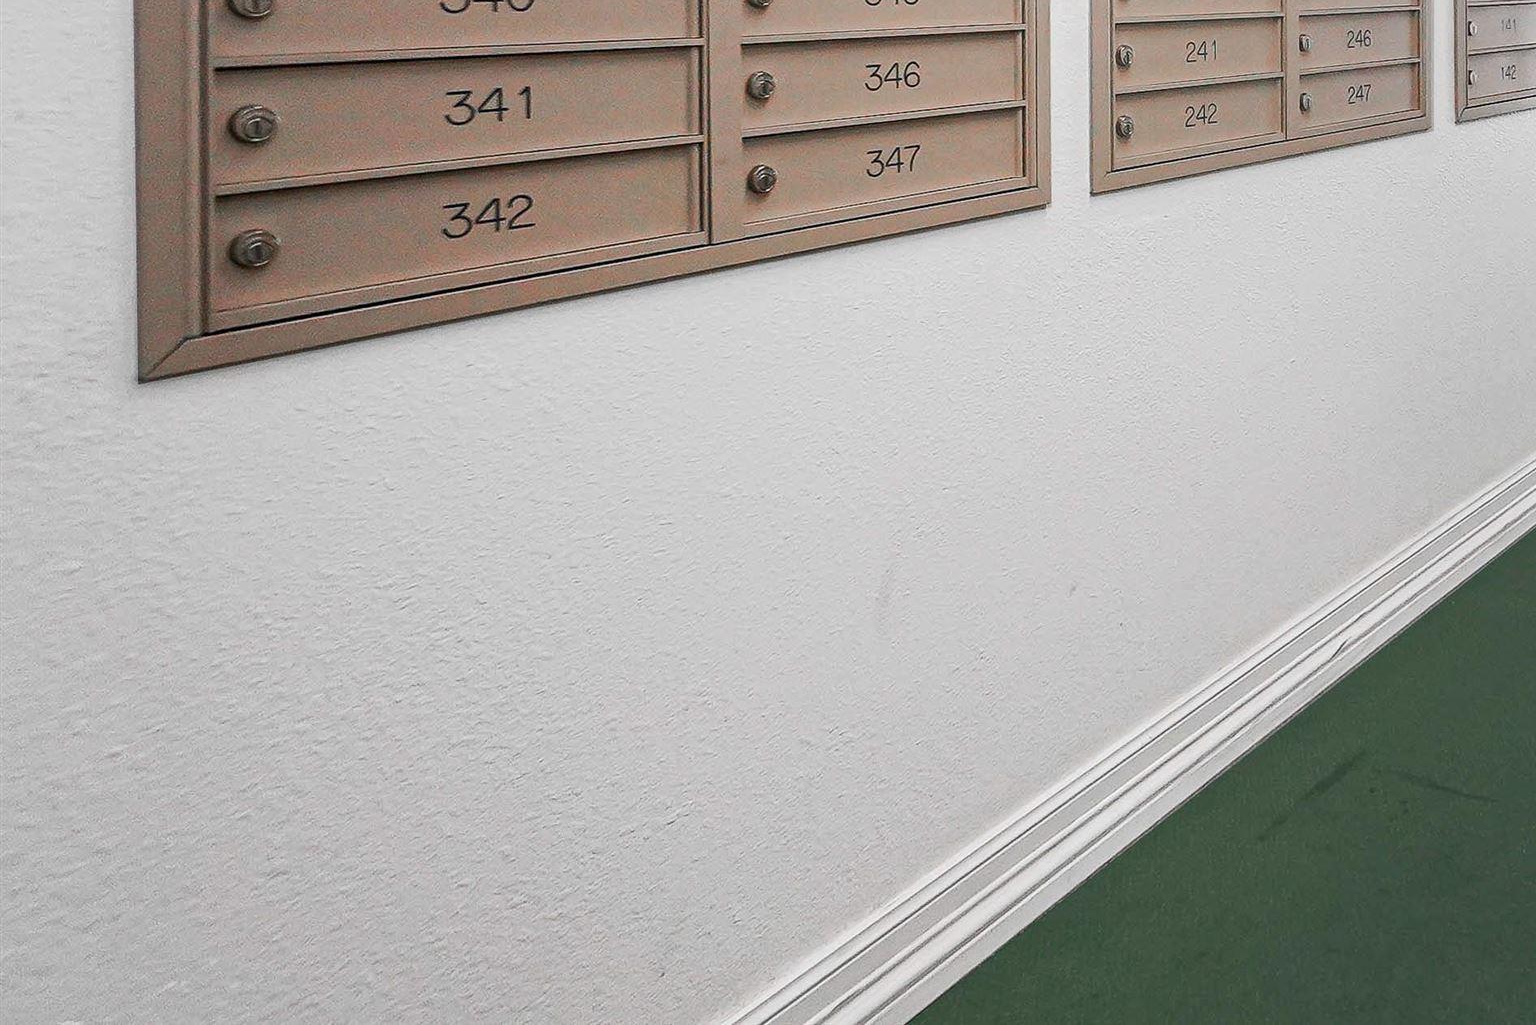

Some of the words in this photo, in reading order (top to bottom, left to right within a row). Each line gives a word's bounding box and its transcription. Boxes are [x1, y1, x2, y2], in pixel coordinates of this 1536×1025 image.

[1346, 29, 1372, 48] 246
[1186, 40, 1218, 63] 241
[865, 61, 920, 91] 346
[1501, 64, 1517, 80] 142
[445, 86, 534, 125] 341
[1347, 84, 1372, 104] 247
[1185, 103, 1217, 128] 242
[867, 145, 920, 177] 347
[441, 194, 536, 239] 342
